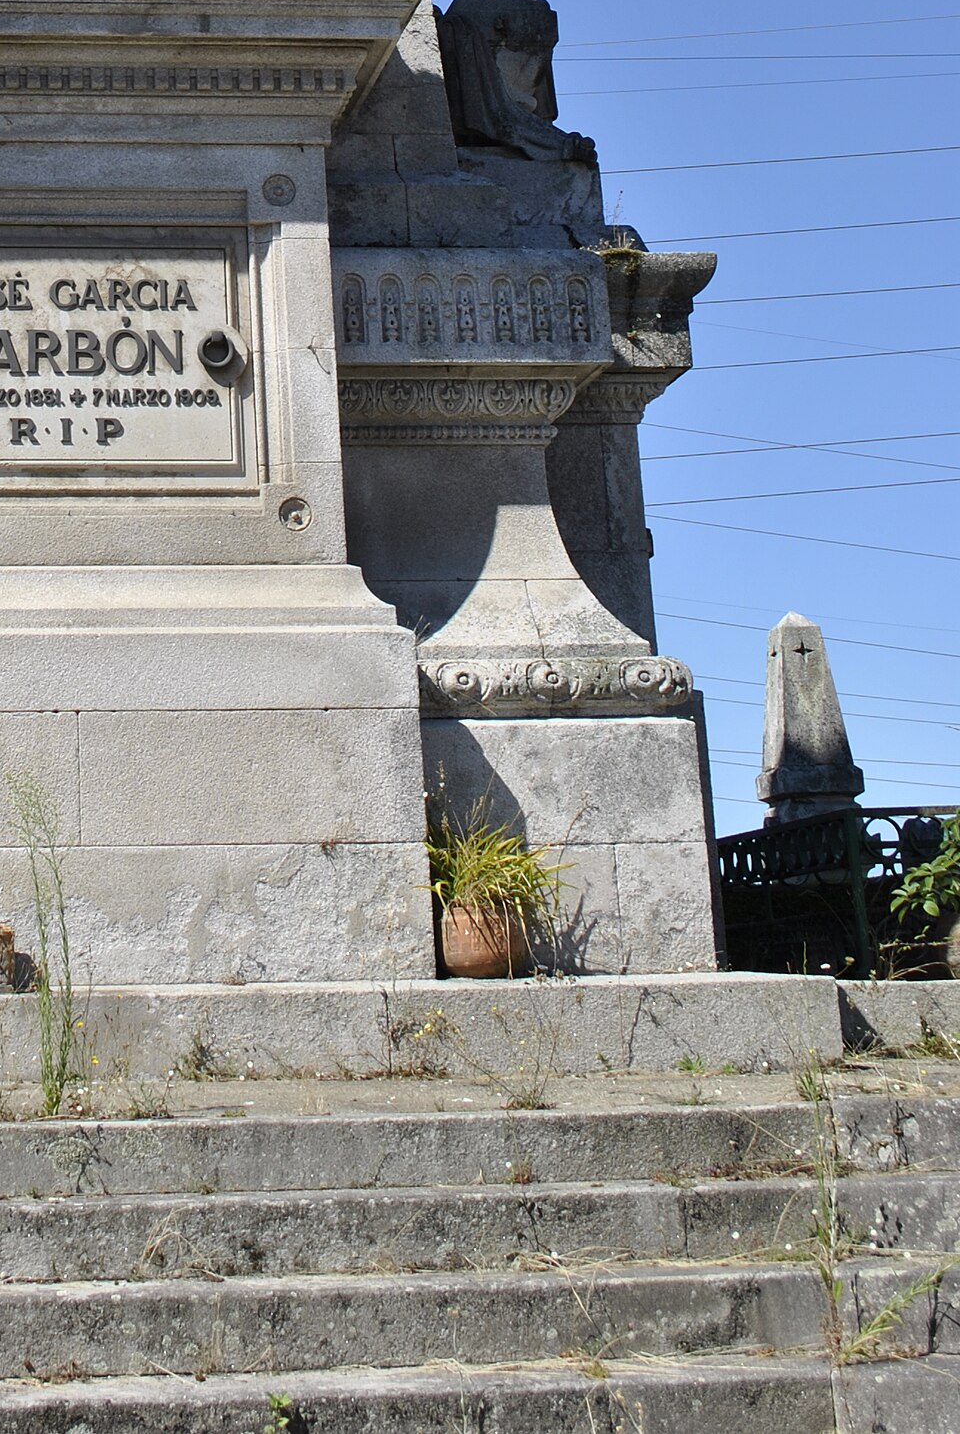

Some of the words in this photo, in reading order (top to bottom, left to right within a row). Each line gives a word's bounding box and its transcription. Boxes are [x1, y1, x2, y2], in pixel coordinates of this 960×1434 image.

[49, 278, 198, 312] GARCIA
[92, 388, 104, 408] 7
[106, 388, 172, 408] MARZO
